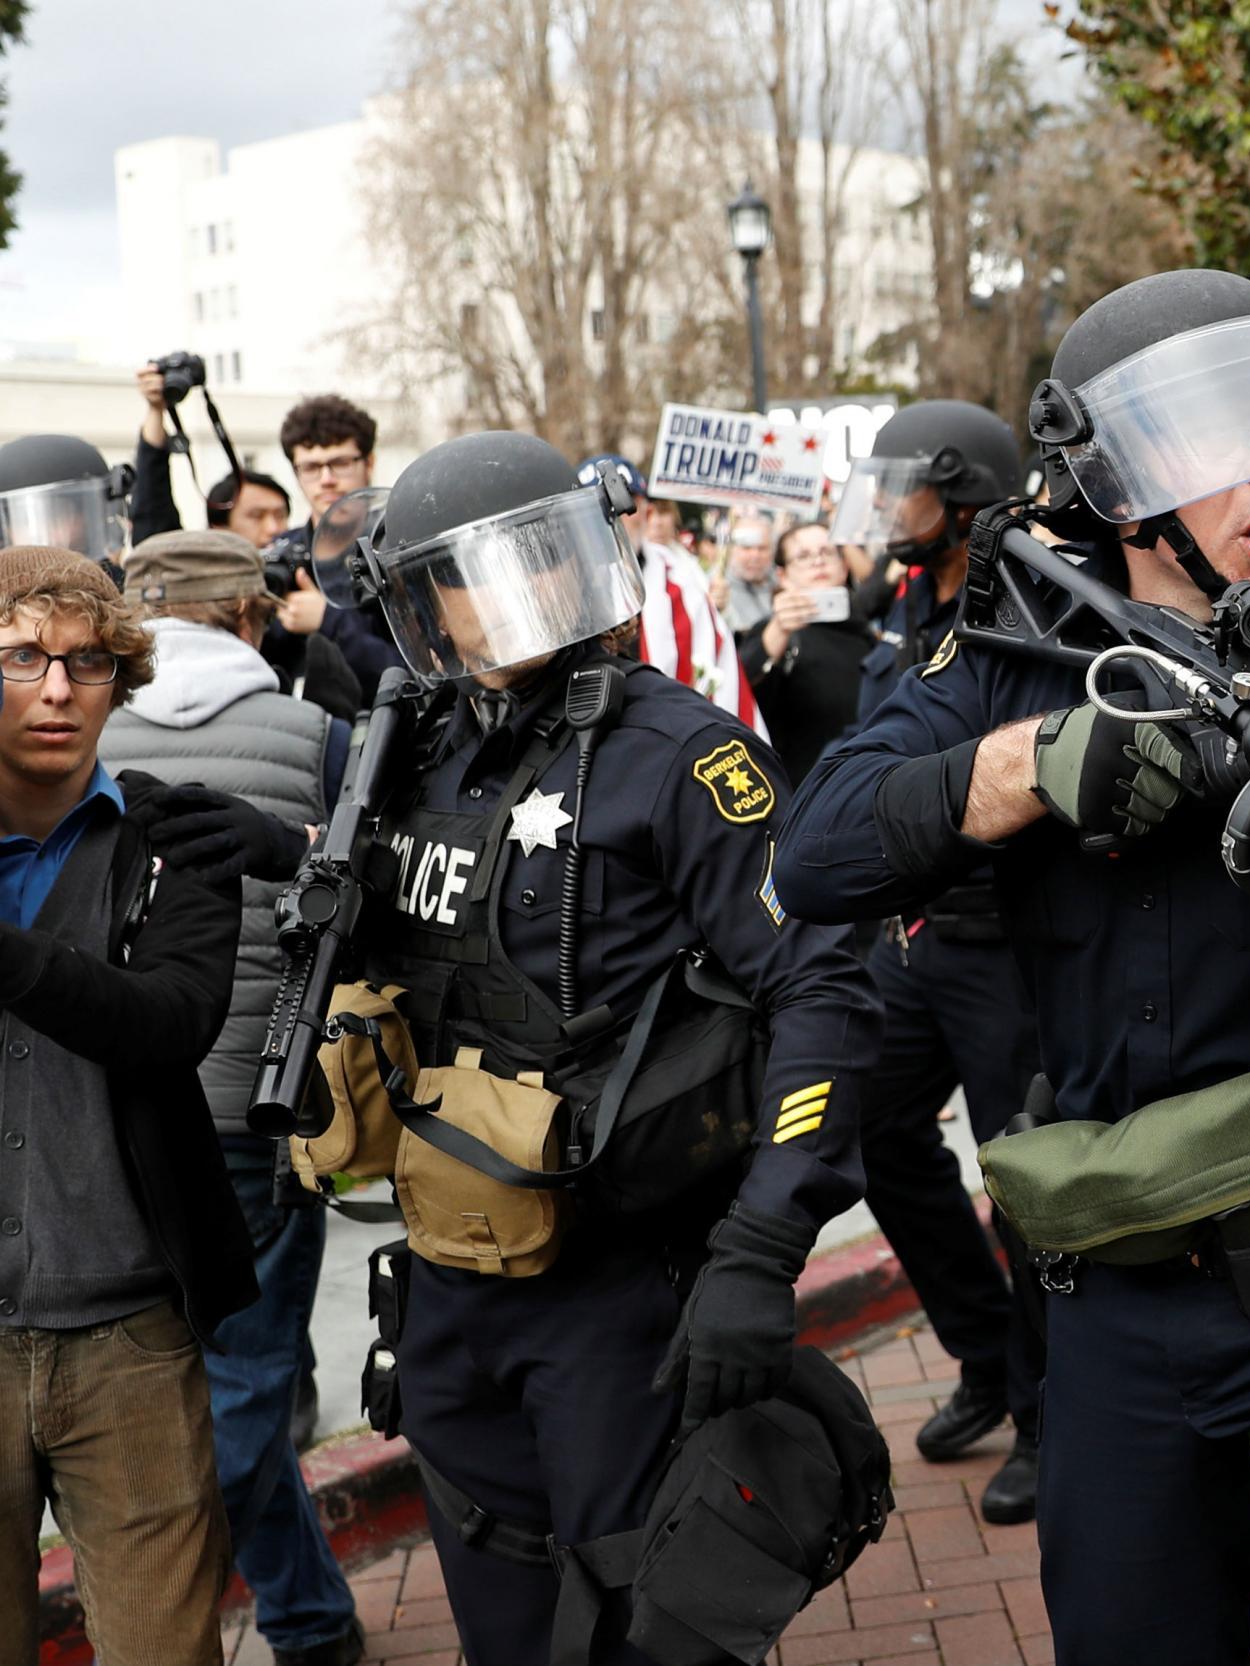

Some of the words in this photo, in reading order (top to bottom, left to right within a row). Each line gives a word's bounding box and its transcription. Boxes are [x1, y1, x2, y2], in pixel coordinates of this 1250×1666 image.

[670, 413, 751, 444] DONALD
[664, 442, 757, 481] TRUMP
[703, 750, 746, 781] BERKELEY
[733, 787, 768, 814] POLICE
